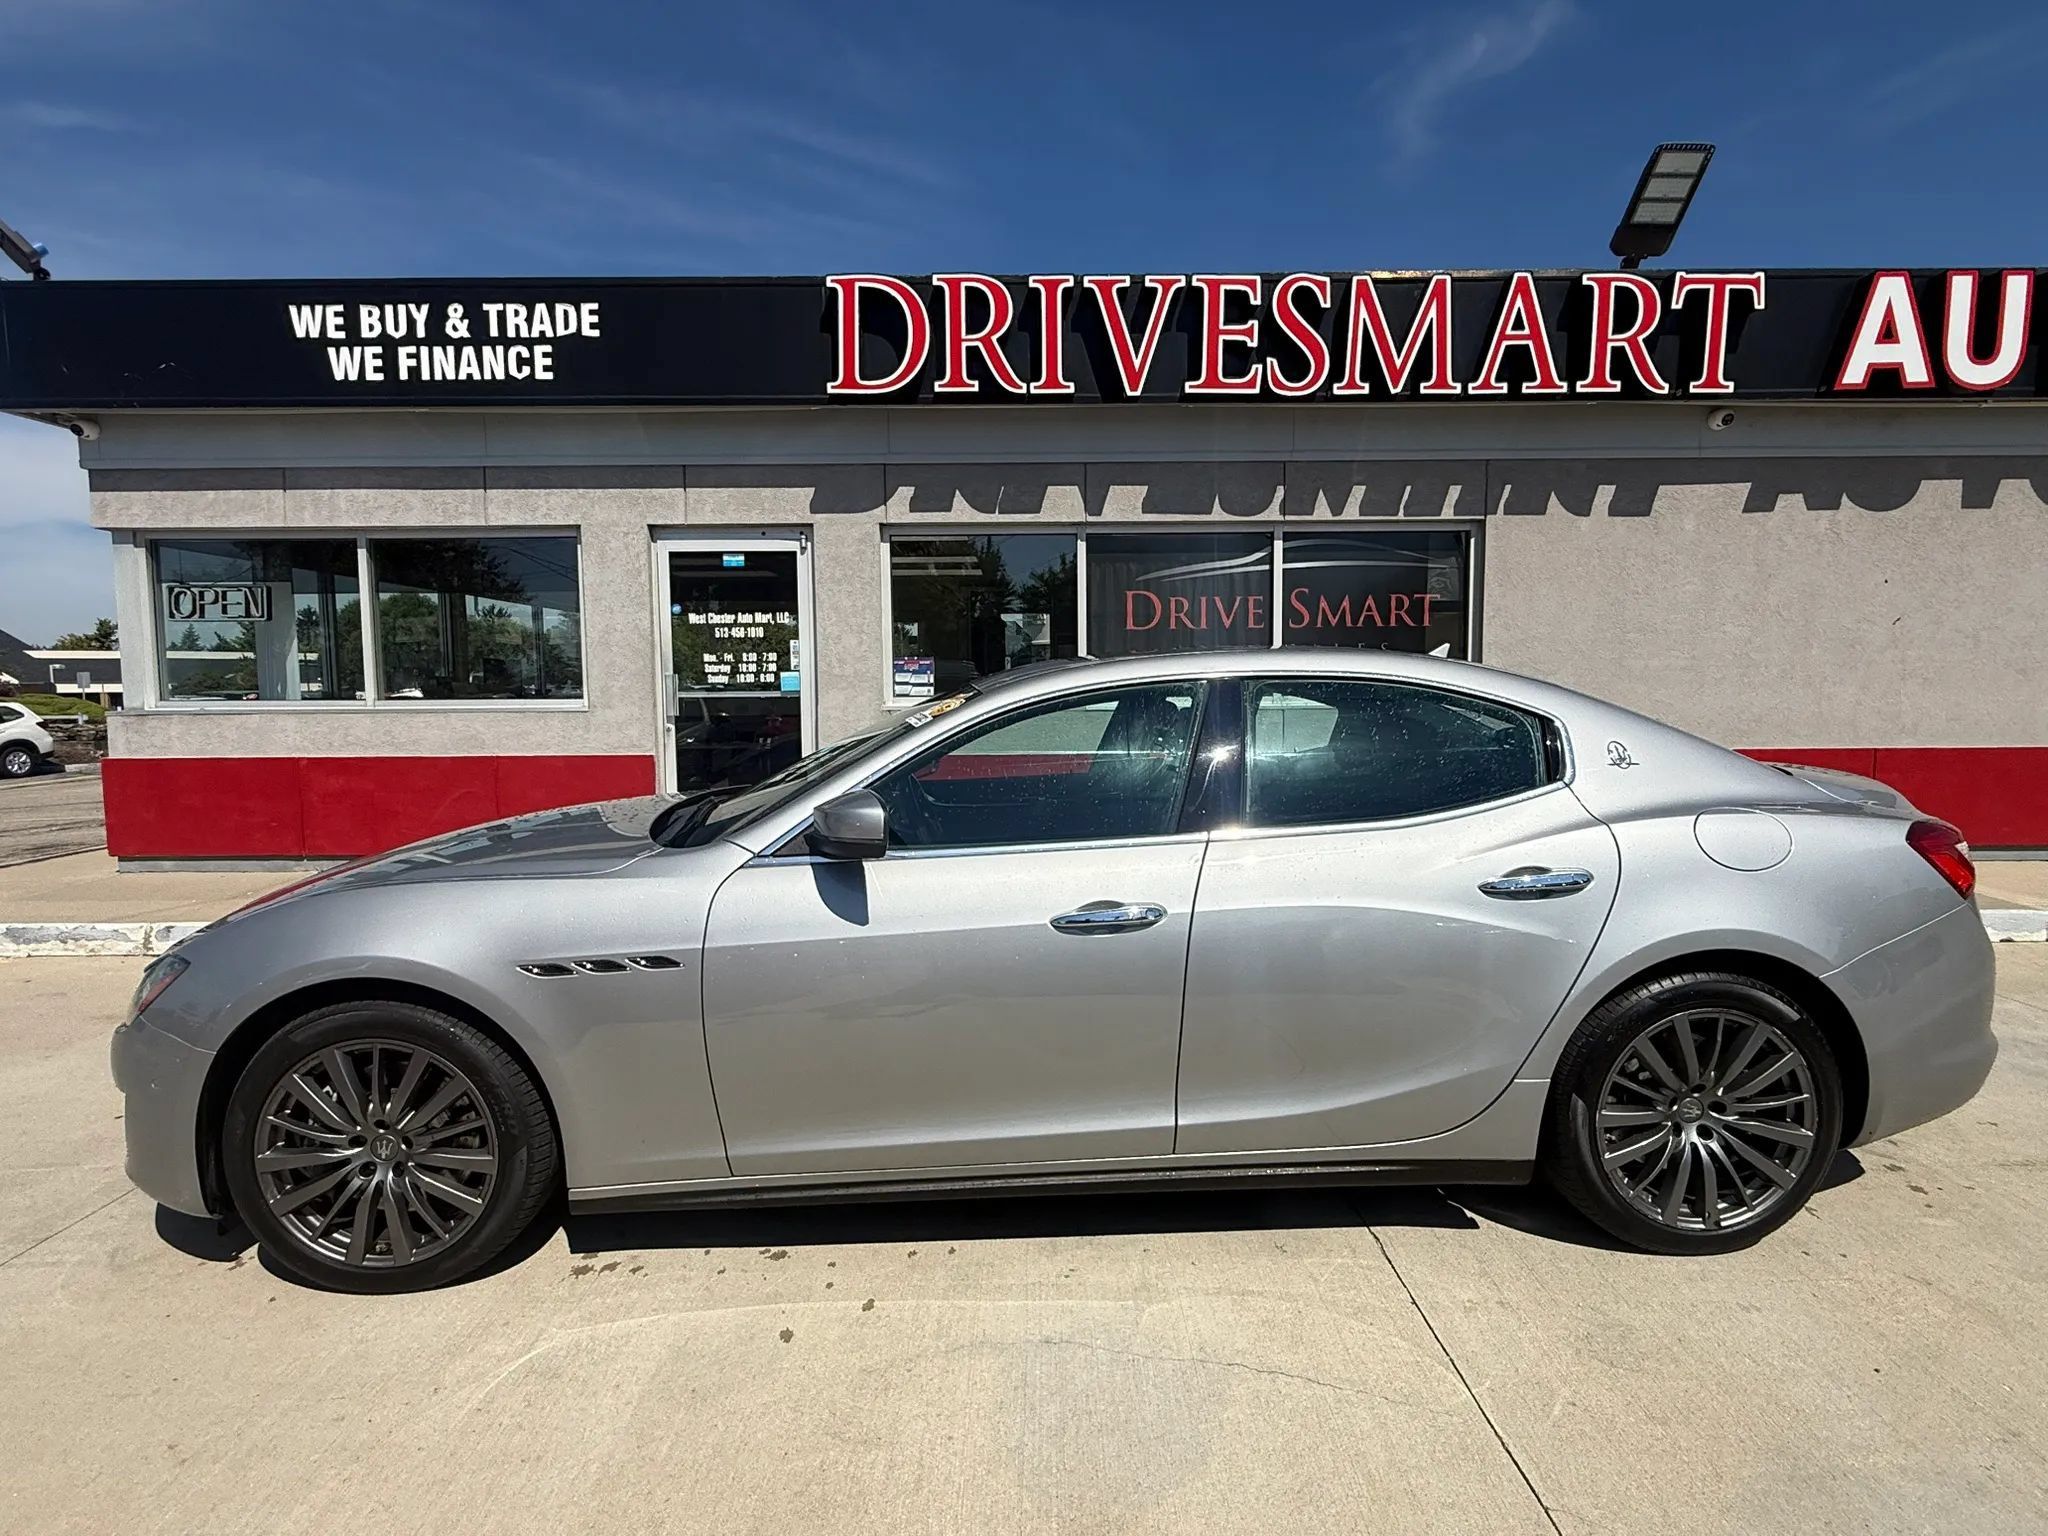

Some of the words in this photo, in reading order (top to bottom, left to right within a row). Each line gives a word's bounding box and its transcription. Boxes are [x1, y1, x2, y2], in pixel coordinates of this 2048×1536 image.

[288, 303, 346, 339] WE
[359, 302, 430, 339] BUY
[444, 302, 471, 339] &
[482, 302, 601, 338] TRADE
[826, 271, 1766, 398] DRIVESMART
[1833, 269, 2034, 391] AU
[327, 345, 385, 381] WE
[397, 344, 554, 381] FINANCE
[169, 586, 265, 619] OPEN
[688, 612, 706, 624] West
[707, 612, 735, 624] Chester
[737, 611, 753, 624] Auto
[776, 611, 790, 624] LLC
[1124, 590, 1265, 630] DRIVE
[1288, 588, 1441, 629] SMART
[704, 663, 731, 674] Saturday
[707, 674, 729, 685] Sunday
